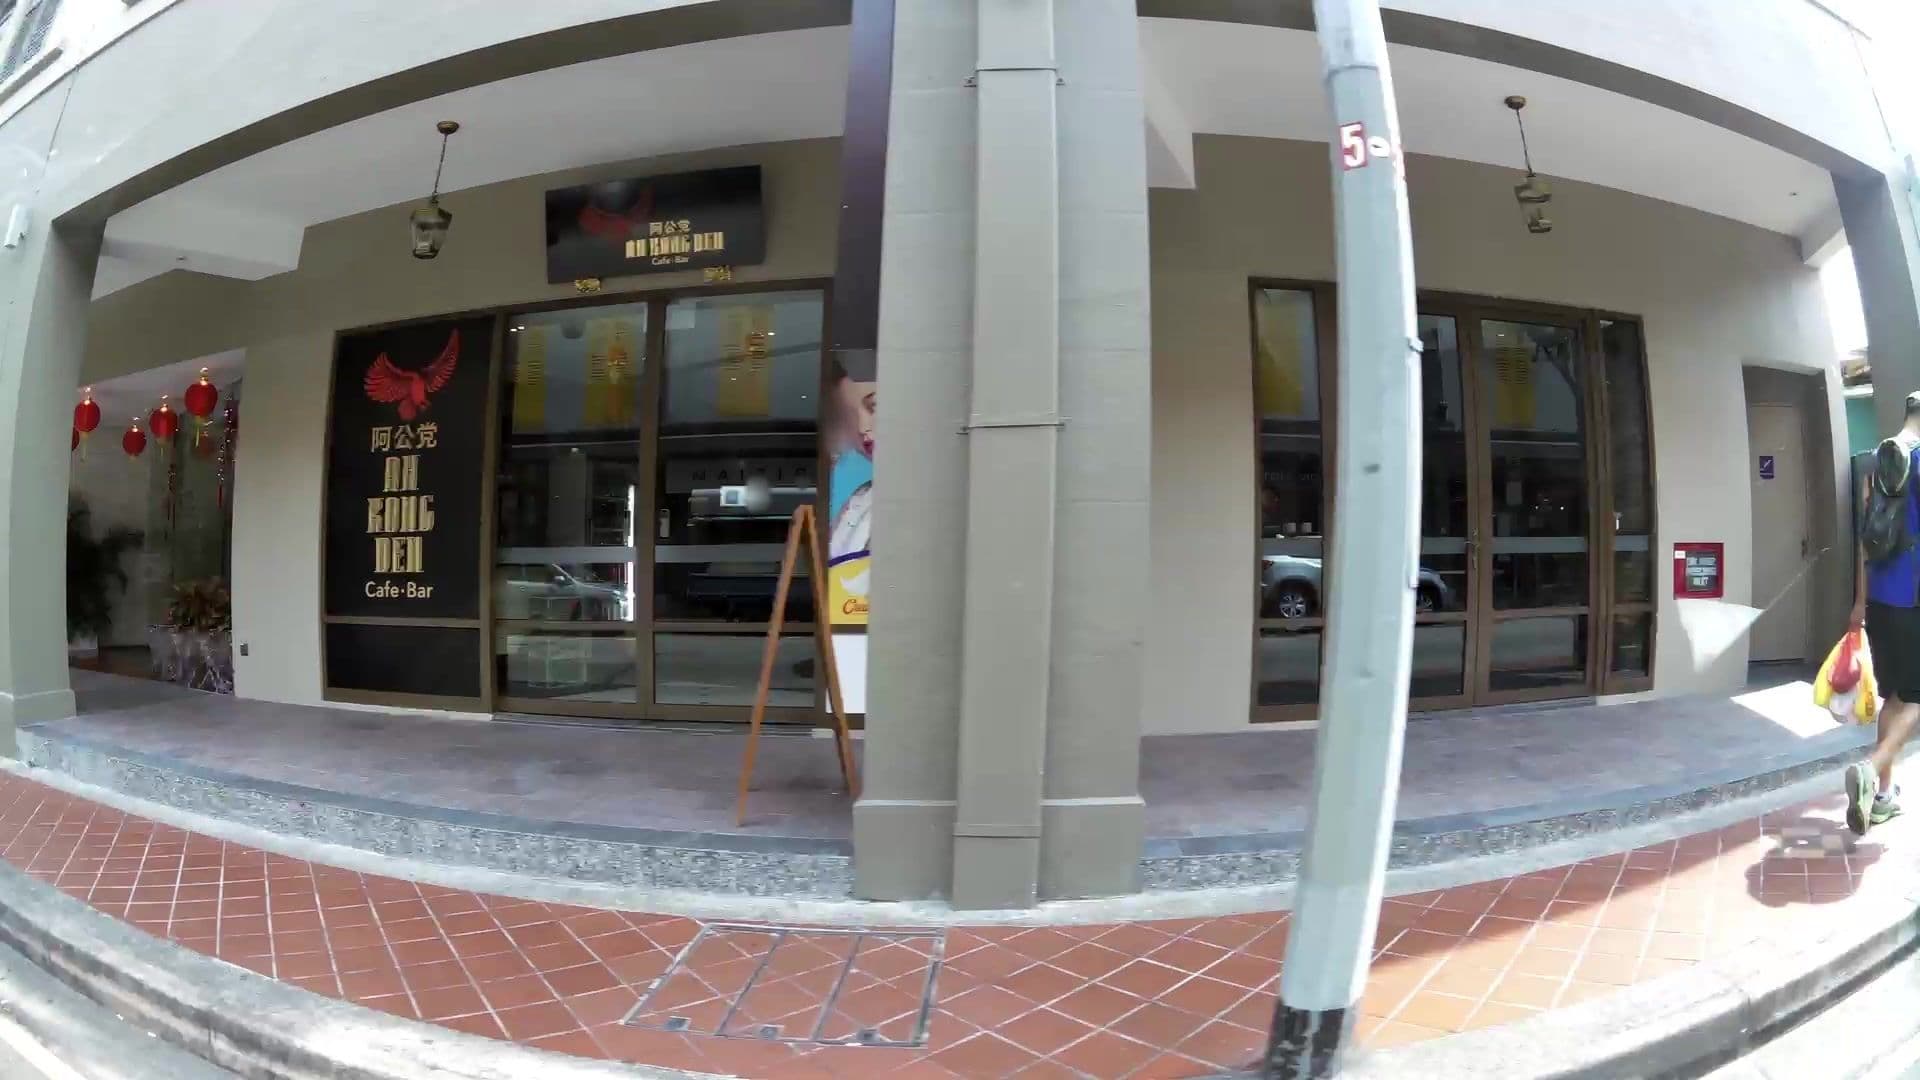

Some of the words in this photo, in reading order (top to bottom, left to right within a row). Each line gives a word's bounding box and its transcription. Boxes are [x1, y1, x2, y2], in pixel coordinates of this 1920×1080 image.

[371, 422, 438, 452] 阿公党
[382, 454, 420, 492] AH
[366, 495, 435, 533] KONG
[374, 536, 424, 573] DEN
